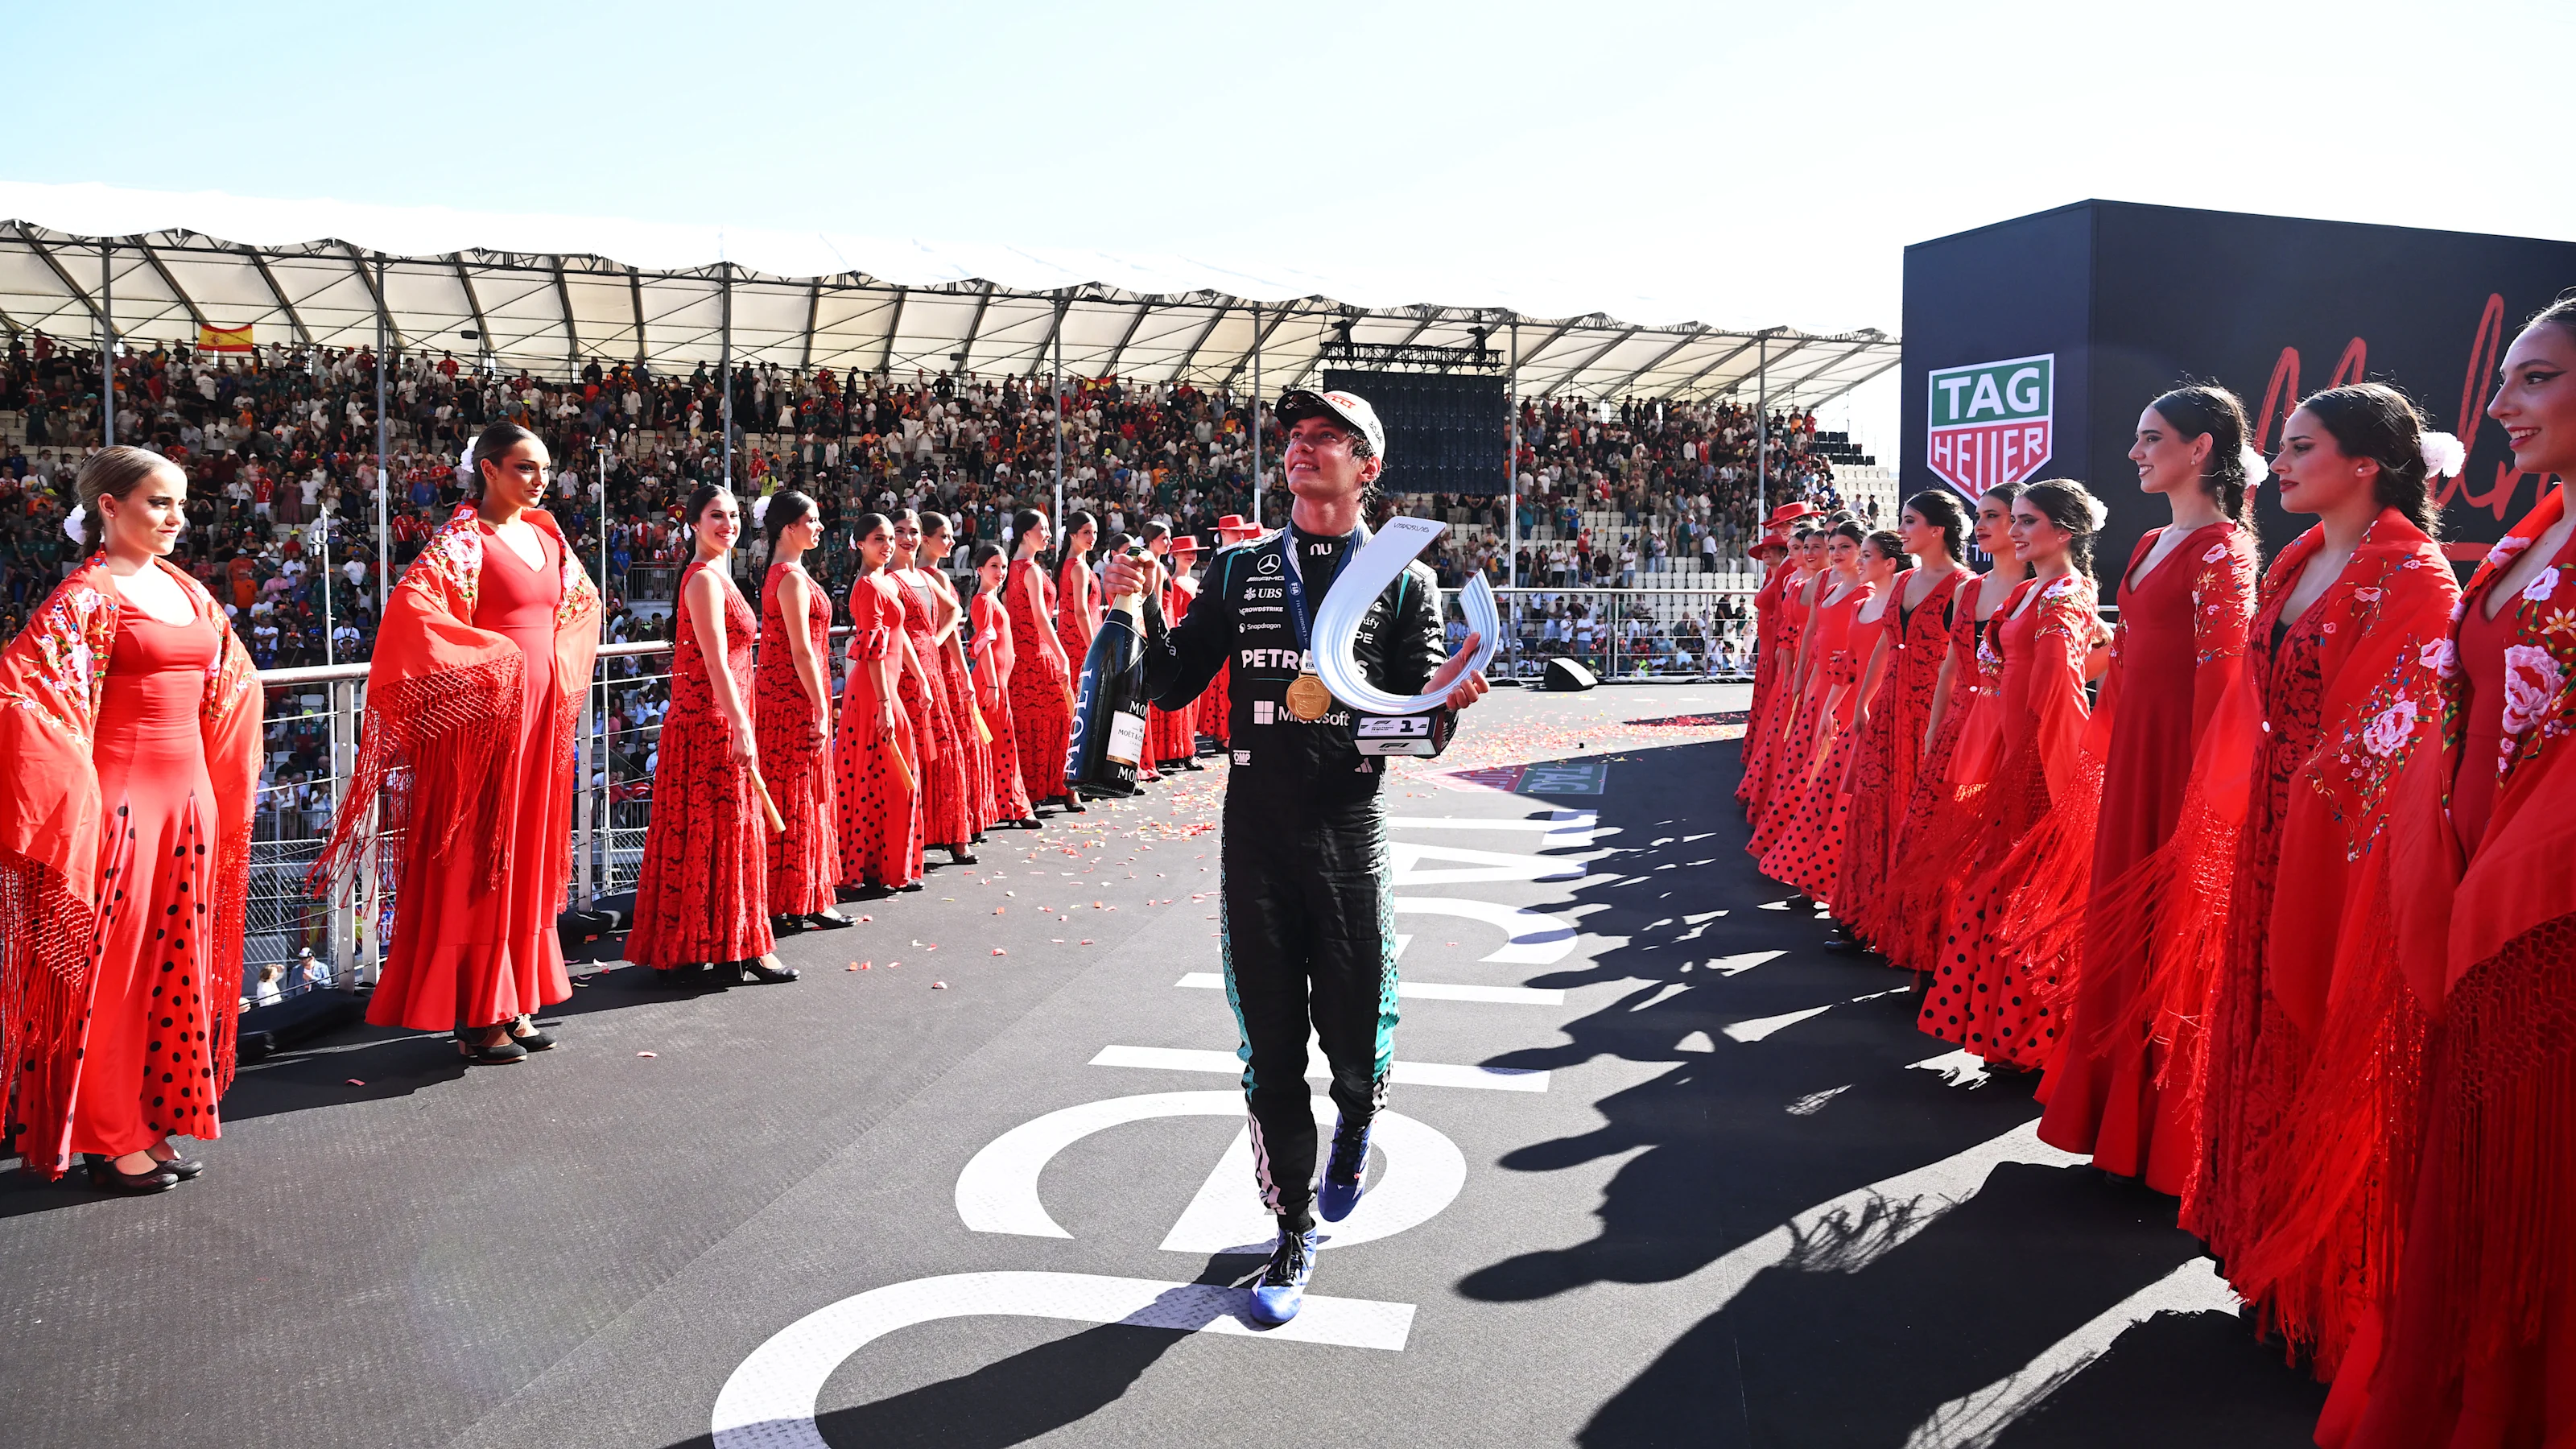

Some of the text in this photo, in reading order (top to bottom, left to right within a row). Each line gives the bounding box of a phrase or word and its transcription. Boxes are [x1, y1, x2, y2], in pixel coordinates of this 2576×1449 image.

[1938, 367, 2040, 420] TAG
[1934, 427, 2043, 497] HEUER
[1310, 543, 1332, 556] nu
[1257, 588, 1283, 599] UBS
[1290, 582, 1300, 595] FIA
[1247, 622, 1282, 631] Snapdragon
[1241, 648, 1369, 679] PETRS
[1129, 700, 1147, 717] MO
[1278, 706, 1350, 726] Msoft
[1400, 720, 1414, 733] 1
[1233, 752, 1251, 763] OMP
[1117, 766, 1136, 783] MO
[1528, 766, 1593, 791] TAG
